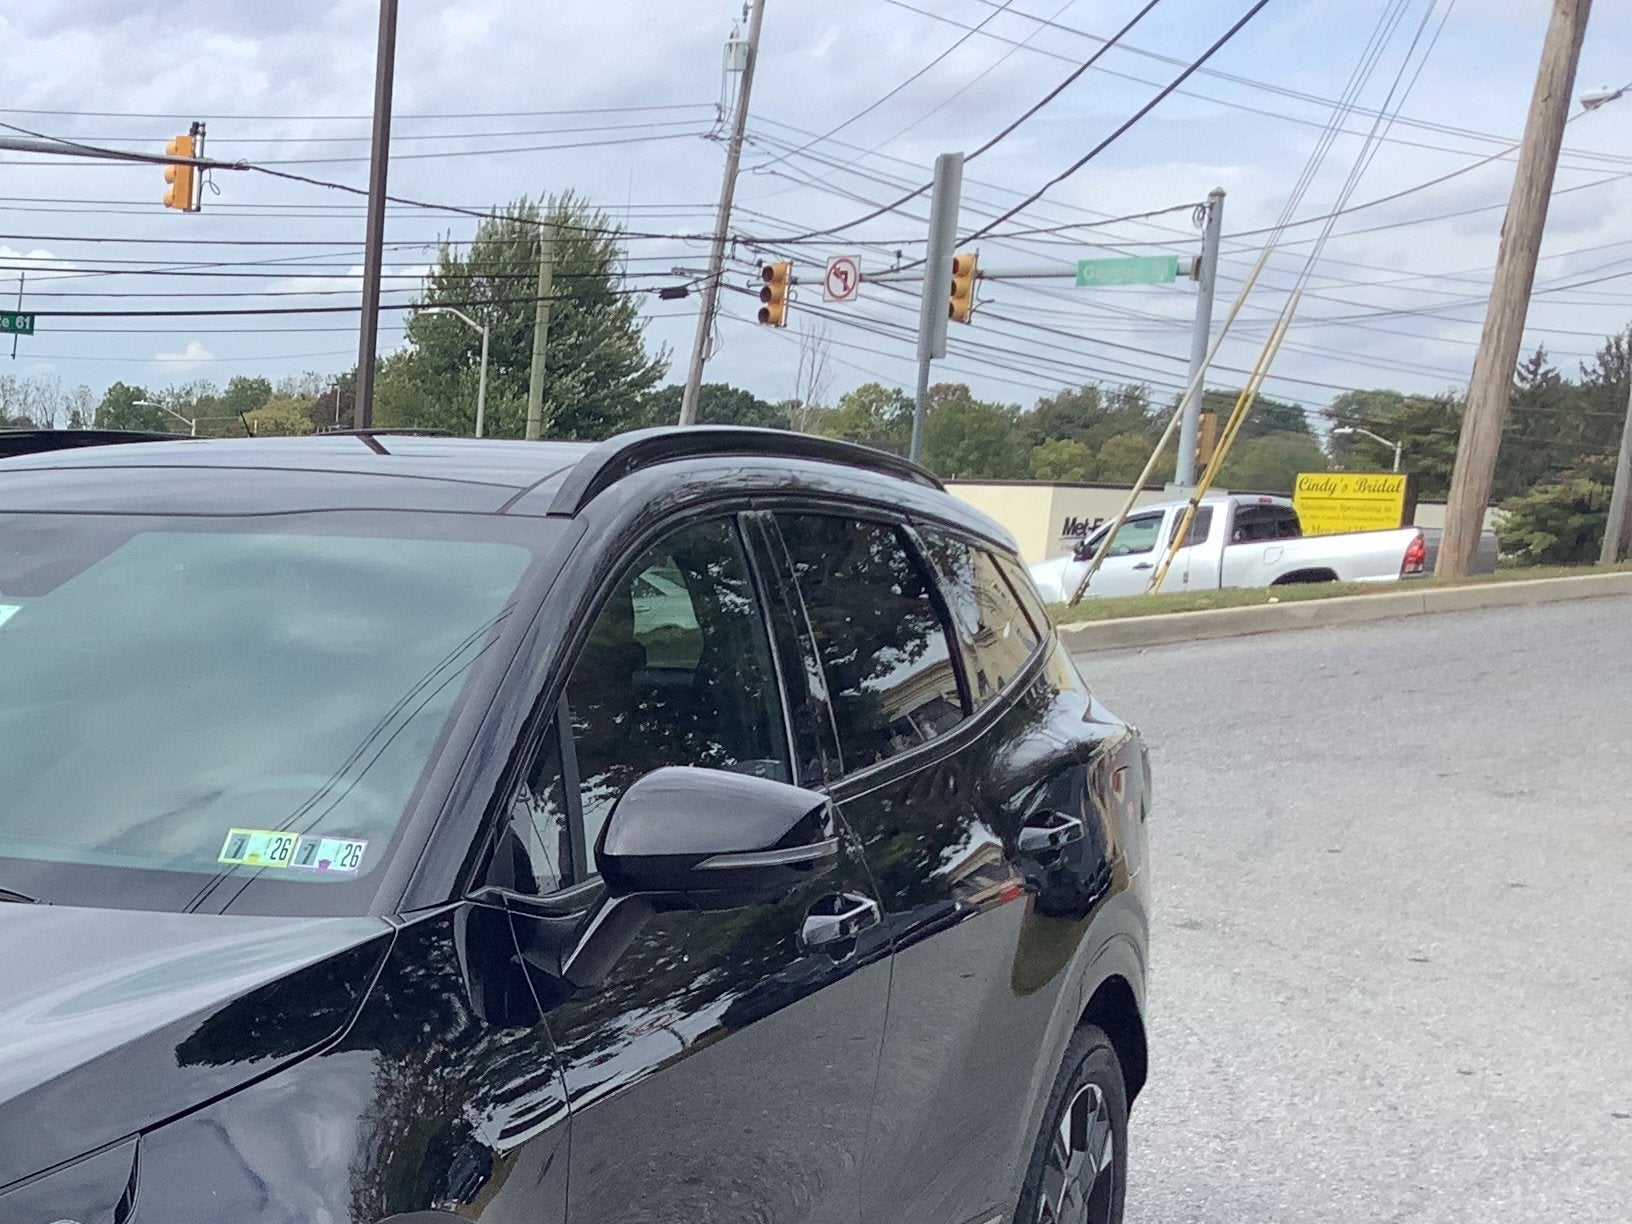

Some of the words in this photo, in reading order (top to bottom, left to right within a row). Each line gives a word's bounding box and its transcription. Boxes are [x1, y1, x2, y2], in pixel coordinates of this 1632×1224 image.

[15, 315, 31, 329] 61
[1298, 477, 1348, 496] Cindy's
[1353, 478, 1404, 494] Bridal
[1062, 517, 1104, 536] Met-E
[232, 838, 246, 859] 7
[270, 837, 292, 861] 26
[302, 843, 316, 865] 7
[340, 843, 362, 868] 26
